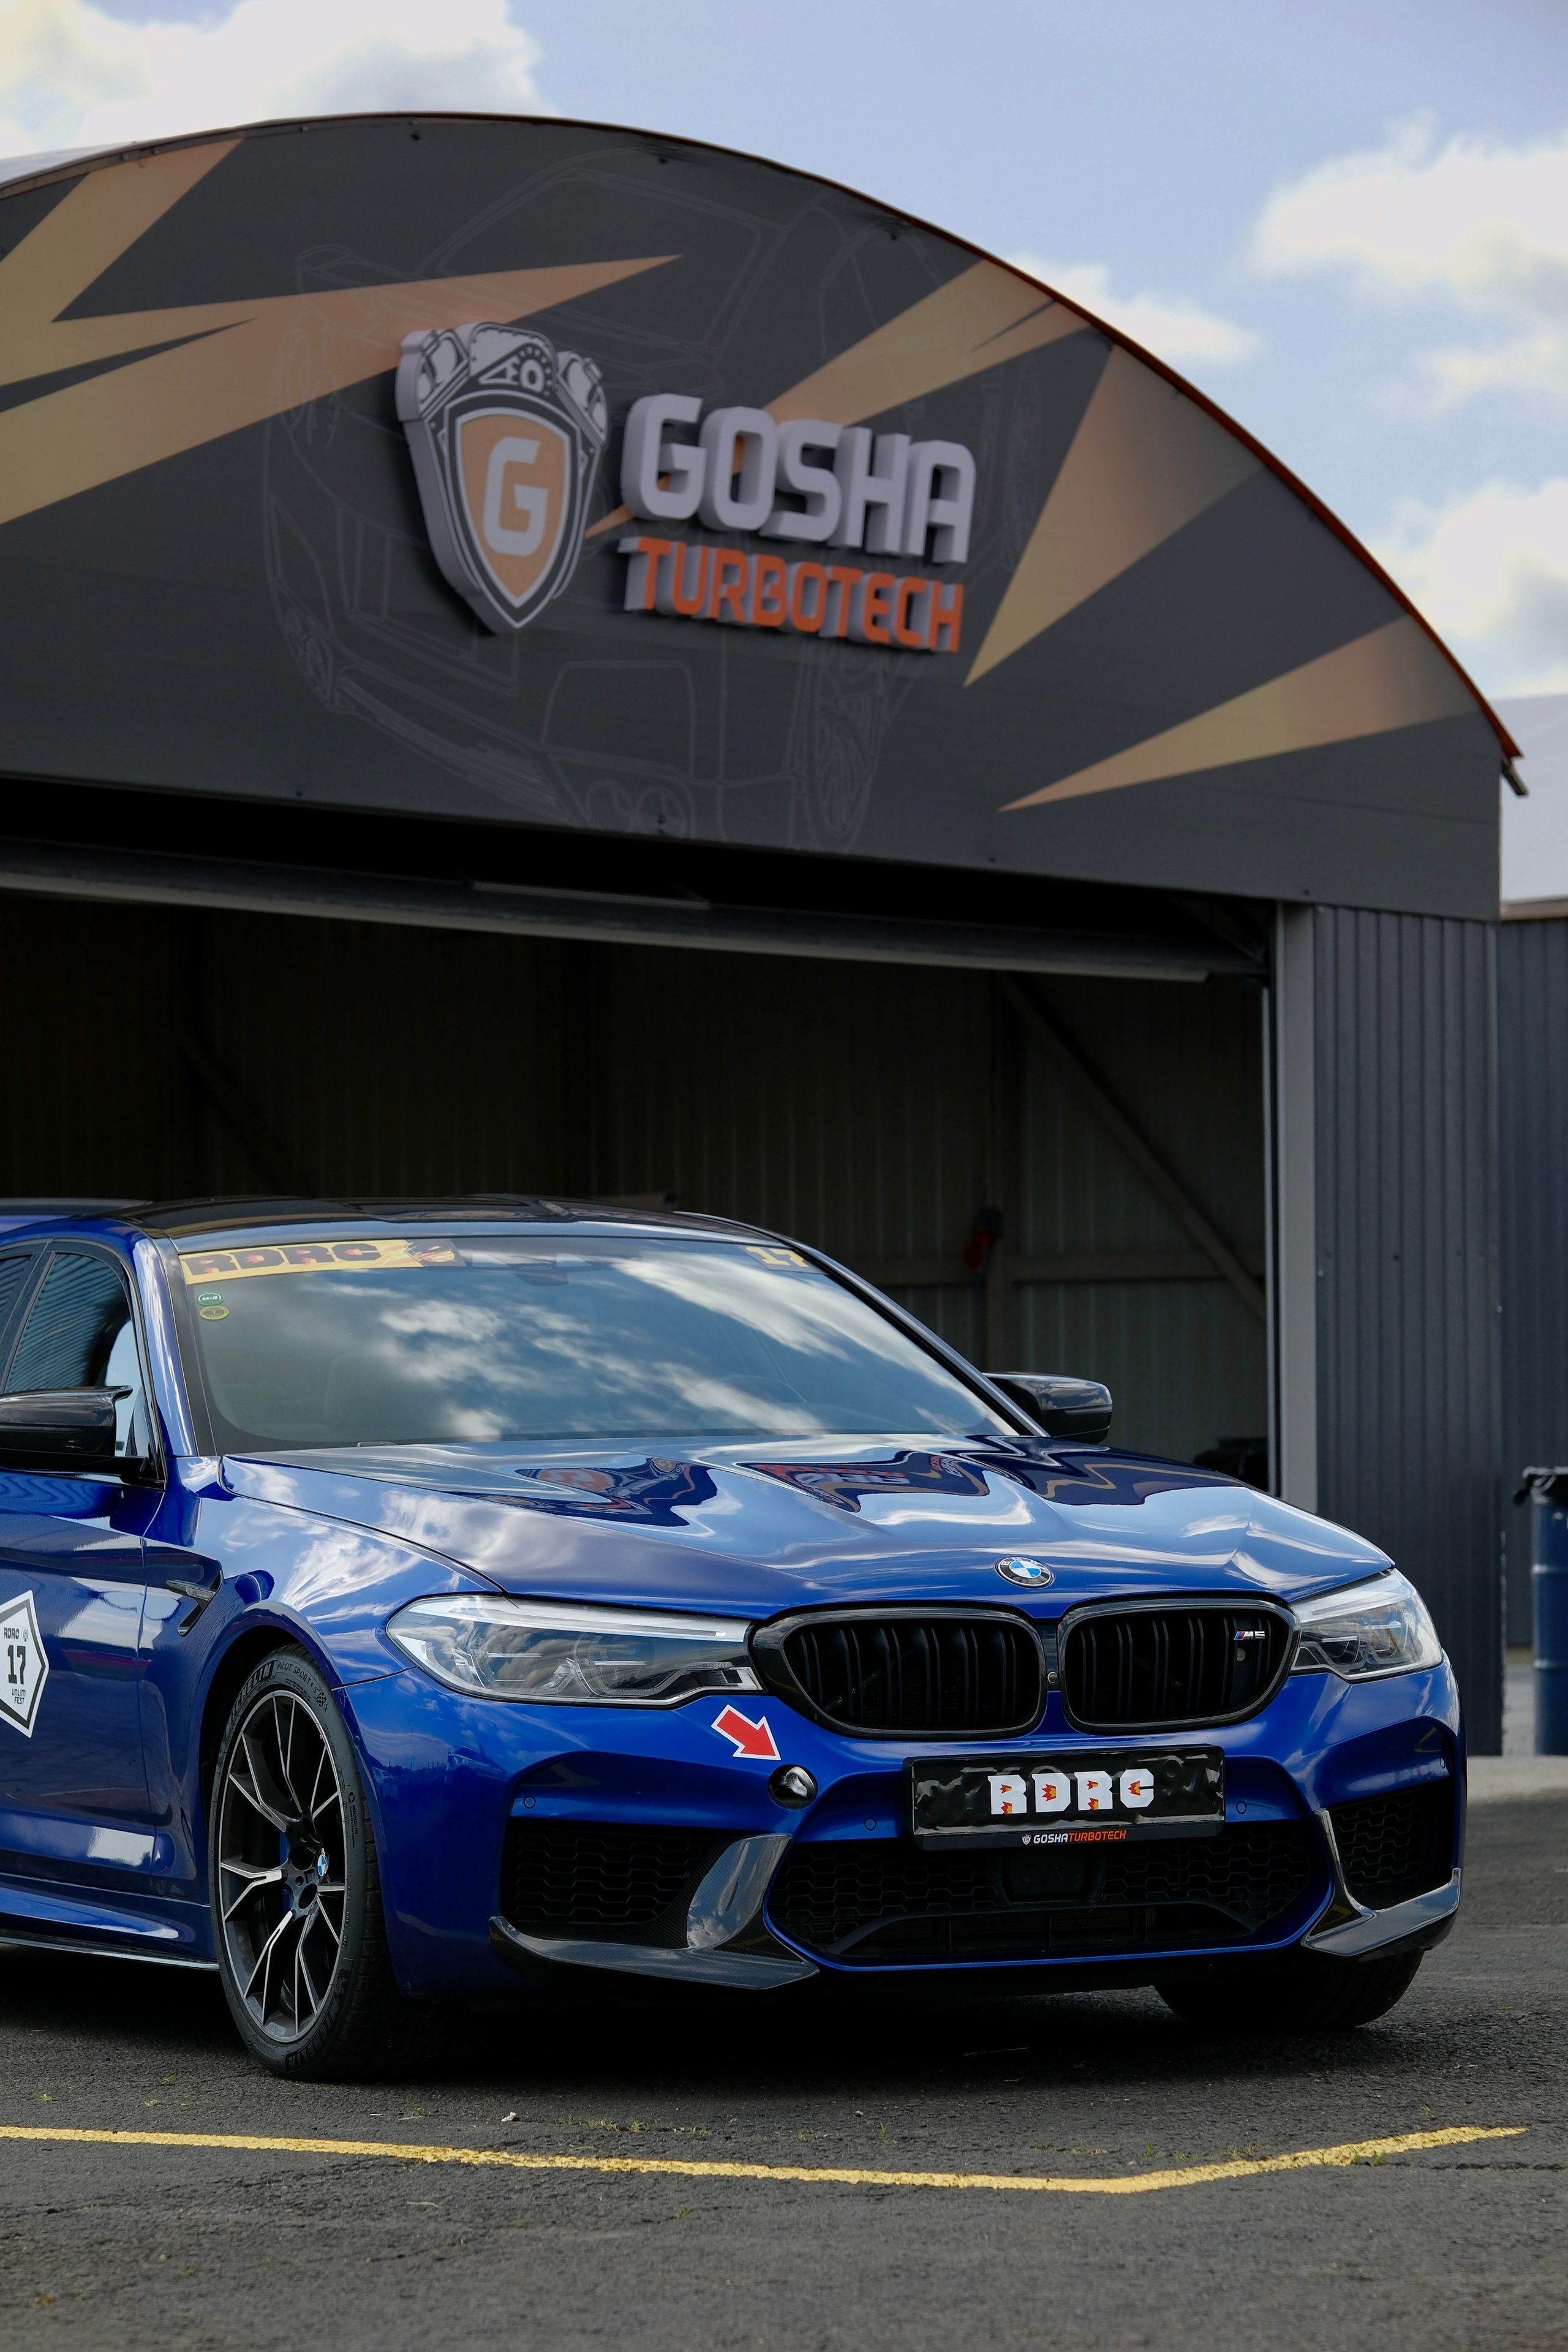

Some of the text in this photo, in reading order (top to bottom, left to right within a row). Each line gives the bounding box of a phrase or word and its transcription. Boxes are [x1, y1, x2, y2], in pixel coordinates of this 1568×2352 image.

[483, 436, 548, 556] G
[620, 393, 976, 564] GOSHA
[617, 536, 965, 653] TURBOTECH
[183, 1243, 382, 1276] RDRC
[745, 1246, 810, 1268] 17
[4, 1627, 20, 1640] RDRC
[7, 1645, 26, 1685] 17
[277, 1662, 293, 1672] PILOT
[293, 1666, 311, 1684] SPORT
[987, 1768, 1155, 1815] RDRC
